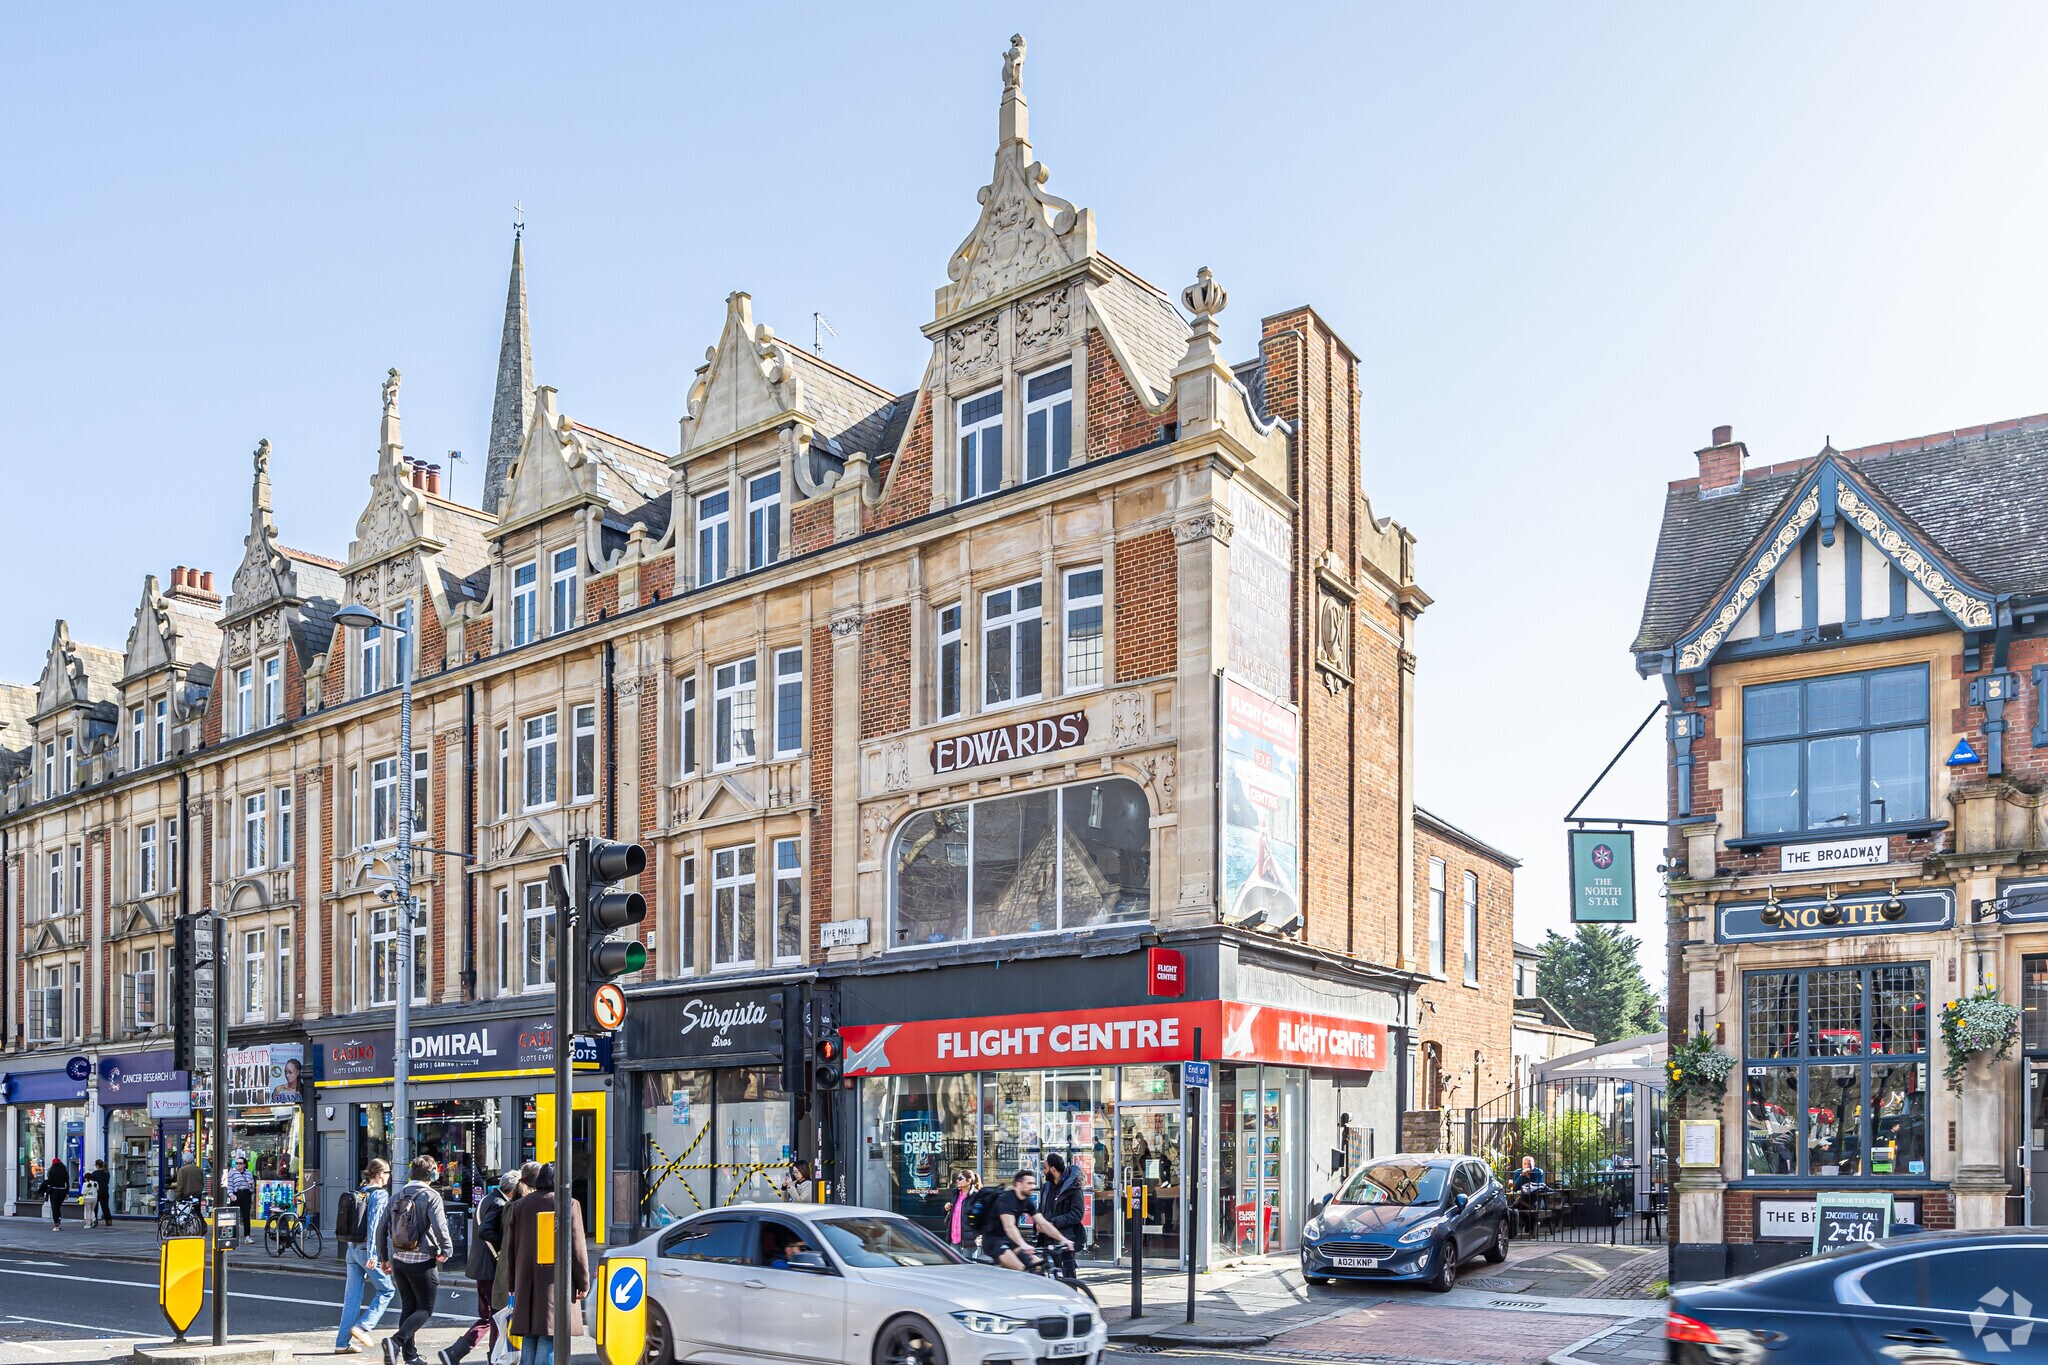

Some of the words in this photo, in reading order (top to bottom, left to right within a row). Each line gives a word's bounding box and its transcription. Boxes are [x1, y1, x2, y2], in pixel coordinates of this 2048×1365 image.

[936, 712, 1083, 773] EDWARDS'
[1787, 851, 1811, 863] THE
[1817, 845, 1883, 862] BROADWAY
[1594, 878, 1613, 886] THE
[1584, 887, 1622, 896] NORTH
[1588, 897, 1619, 906] STAR
[1157, 964, 1177, 973] FLIGHT
[1156, 972, 1177, 981] CENTRE
[408, 1028, 497, 1059] DMIRAL
[519, 1030, 551, 1048] CASI
[711, 1035, 732, 1047] Bros
[937, 1026, 1044, 1059] FLIGHT
[1049, 1018, 1179, 1053] CENTRE
[1278, 1021, 1328, 1055] FLIGHT
[1328, 1028, 1375, 1059] CENTRE
[238, 1050, 270, 1065] BEAUTY
[332, 1045, 374, 1061] CASINO
[520, 1054, 536, 1062] SLOTS
[333, 1066, 346, 1075] SLOTS
[347, 1065, 374, 1074] EXPERIENCE
[413, 1062, 428, 1070] SLOTS
[1188, 1065, 1198, 1073] End
[1199, 1067, 1206, 1075] of
[122, 1074, 142, 1083] CANCER
[143, 1072, 168, 1082] RESEARCH
[169, 1071, 177, 1081] UK
[1185, 1074, 1195, 1083] bus
[1196, 1076, 1207, 1084] lane
[904, 1131, 943, 1142] CRUISE
[904, 1143, 943, 1154] DEALS
[1766, 1211, 1796, 1223] THE
[1825, 1211, 1858, 1220] INCOMING
[1862, 1212, 1879, 1221] CALL
[1828, 1221, 1840, 1241] 2
[1845, 1221, 1875, 1243] £16
[1338, 1258, 1355, 1266] AO21
[1356, 1258, 1373, 1267] KNP
